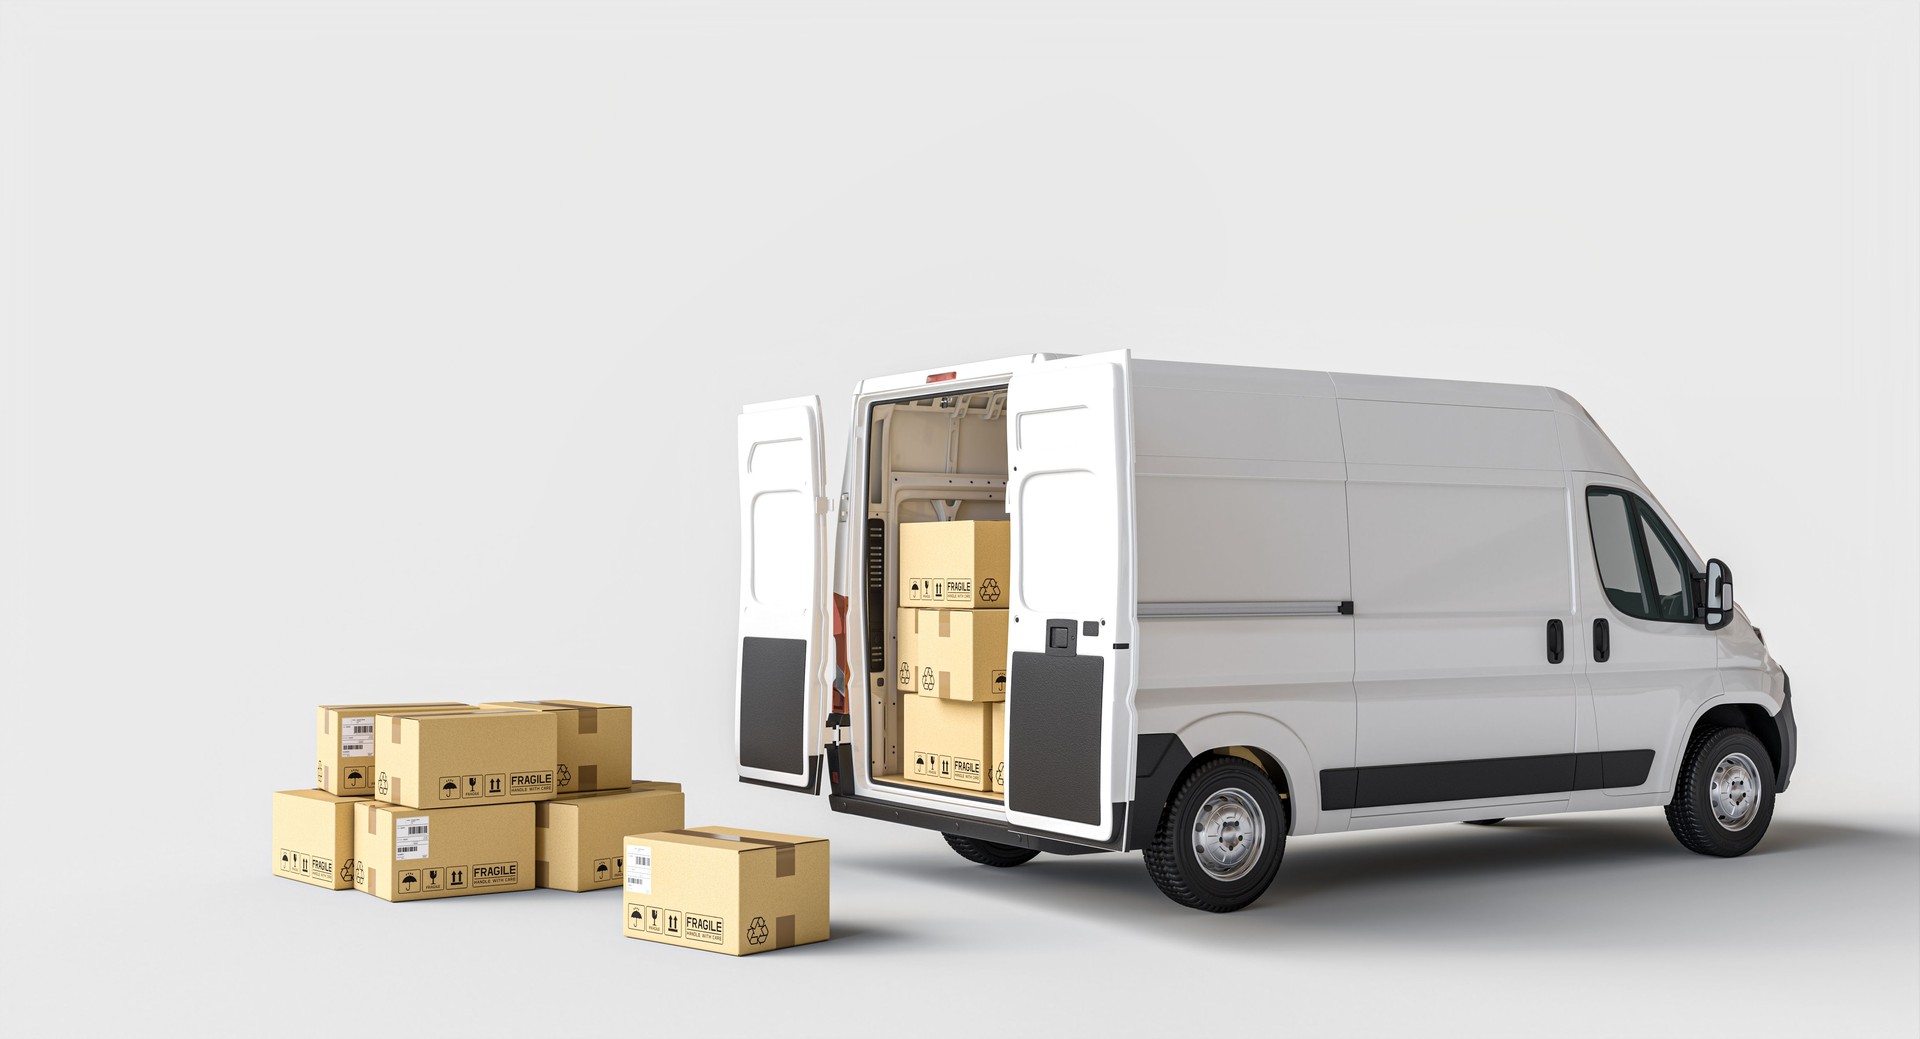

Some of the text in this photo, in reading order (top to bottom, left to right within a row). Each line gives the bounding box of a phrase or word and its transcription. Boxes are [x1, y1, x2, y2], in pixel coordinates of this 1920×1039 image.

[947, 582, 971, 591] FRAGILE
[954, 761, 979, 773] FRAGILE
[511, 774, 551, 785] FRAGILE
[312, 859, 332, 872] FRAGILE
[474, 865, 516, 877] FRAGILE
[686, 917, 722, 932] FRAGILE
